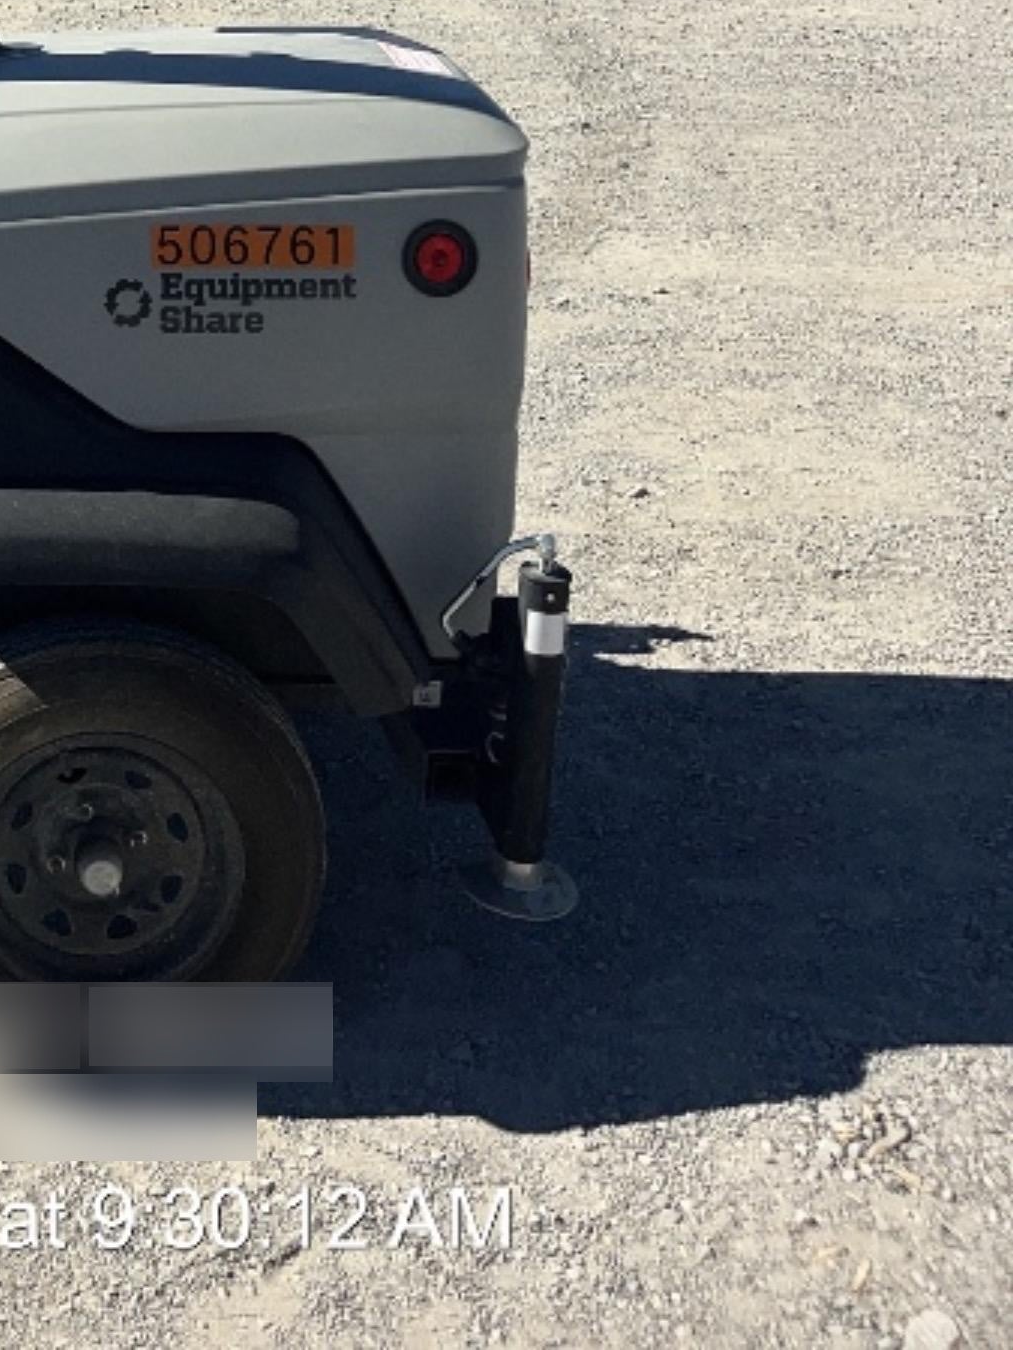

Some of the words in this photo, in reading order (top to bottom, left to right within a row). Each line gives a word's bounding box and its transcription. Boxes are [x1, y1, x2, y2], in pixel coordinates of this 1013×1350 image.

[157, 225, 340, 265] 506761
[160, 272, 357, 306] Equipment
[159, 305, 264, 334] Share
